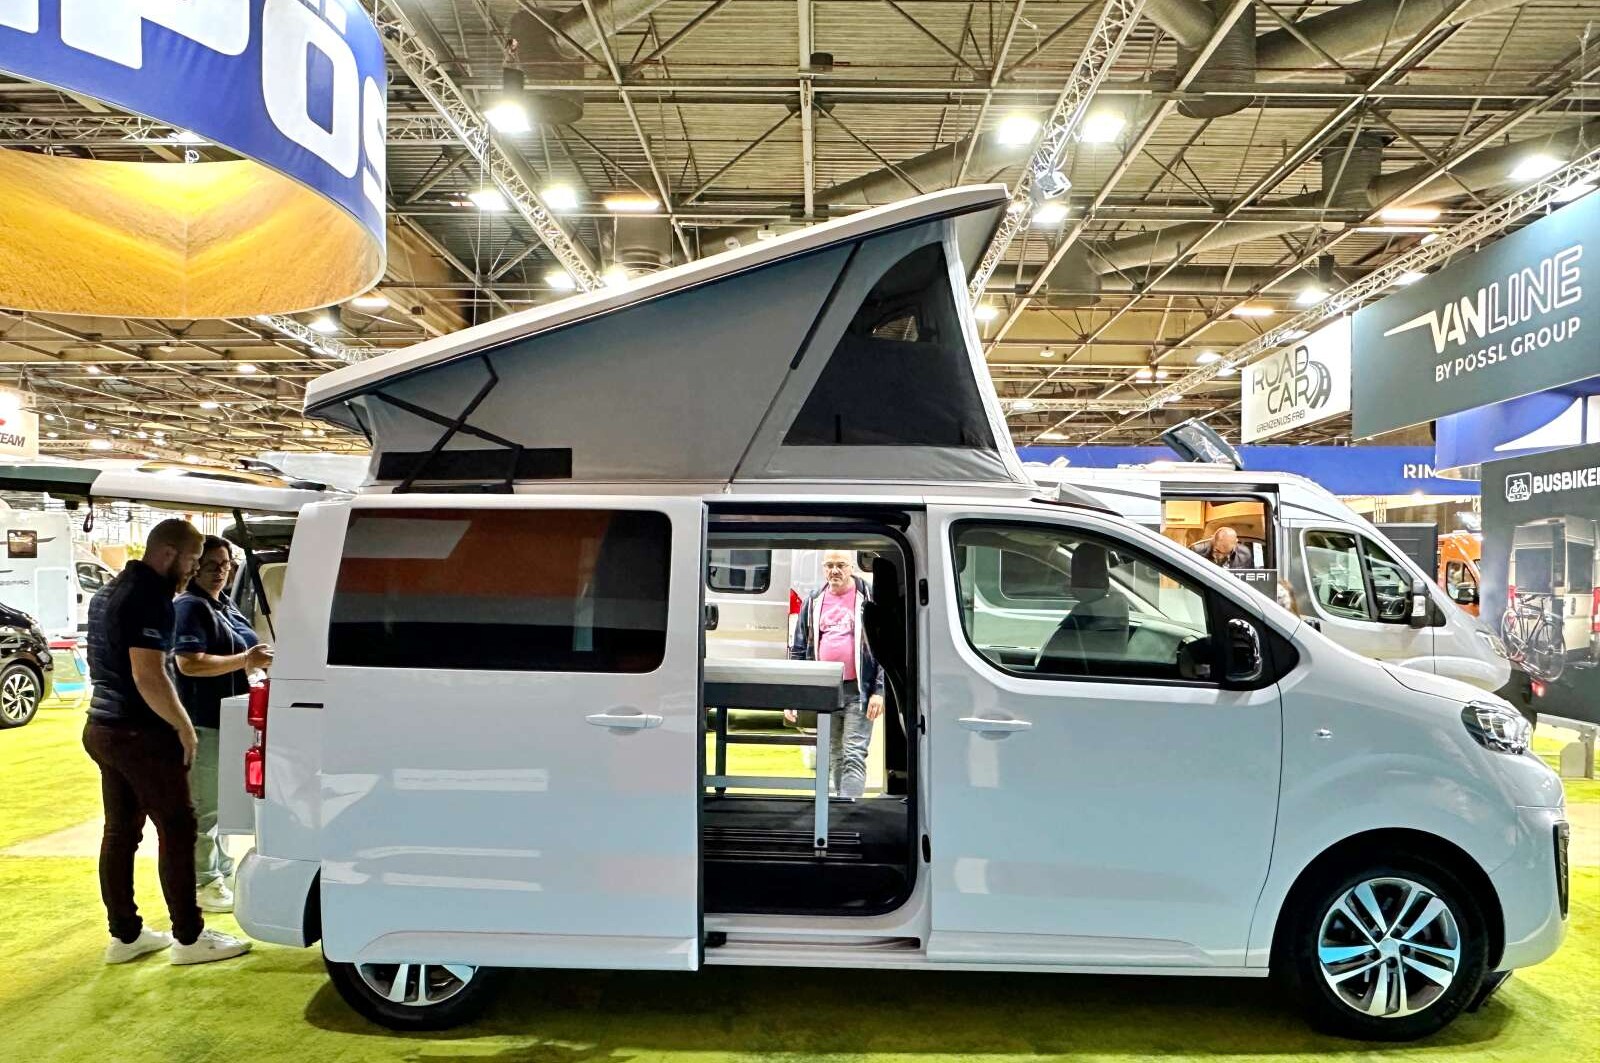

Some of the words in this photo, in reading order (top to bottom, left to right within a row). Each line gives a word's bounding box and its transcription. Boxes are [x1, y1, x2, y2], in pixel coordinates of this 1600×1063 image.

[1384, 244, 1583, 354] VANLINE
[1253, 345, 1309, 395] ROAD
[1435, 361, 1452, 383] BY
[1455, 343, 1507, 376] PÖSSL
[1511, 316, 1580, 356] GROUP
[1268, 374, 1310, 415] CAR
[0, 432, 26, 448] EAM
